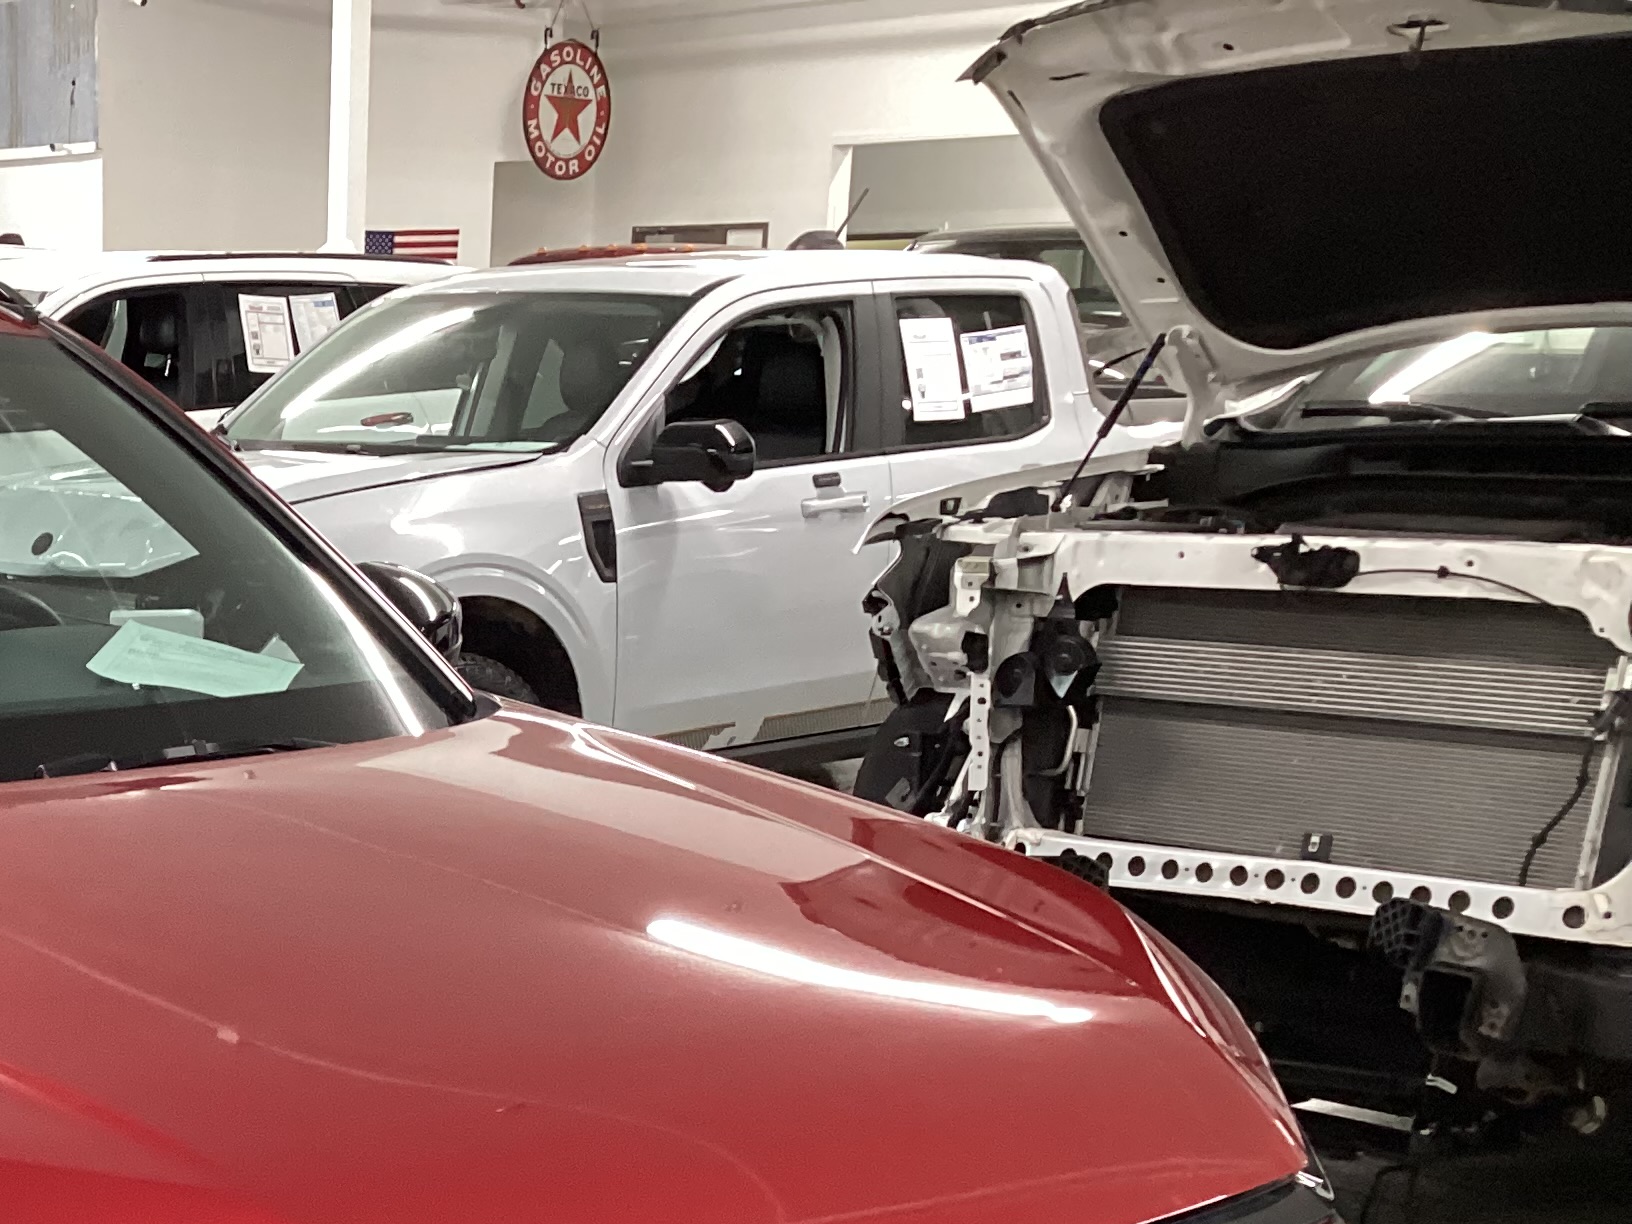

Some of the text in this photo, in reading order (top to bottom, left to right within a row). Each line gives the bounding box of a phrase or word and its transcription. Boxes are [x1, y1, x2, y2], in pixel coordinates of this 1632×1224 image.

[531, 46, 607, 100] GASOLINE
[527, 119, 606, 175] MOTOR OIL
